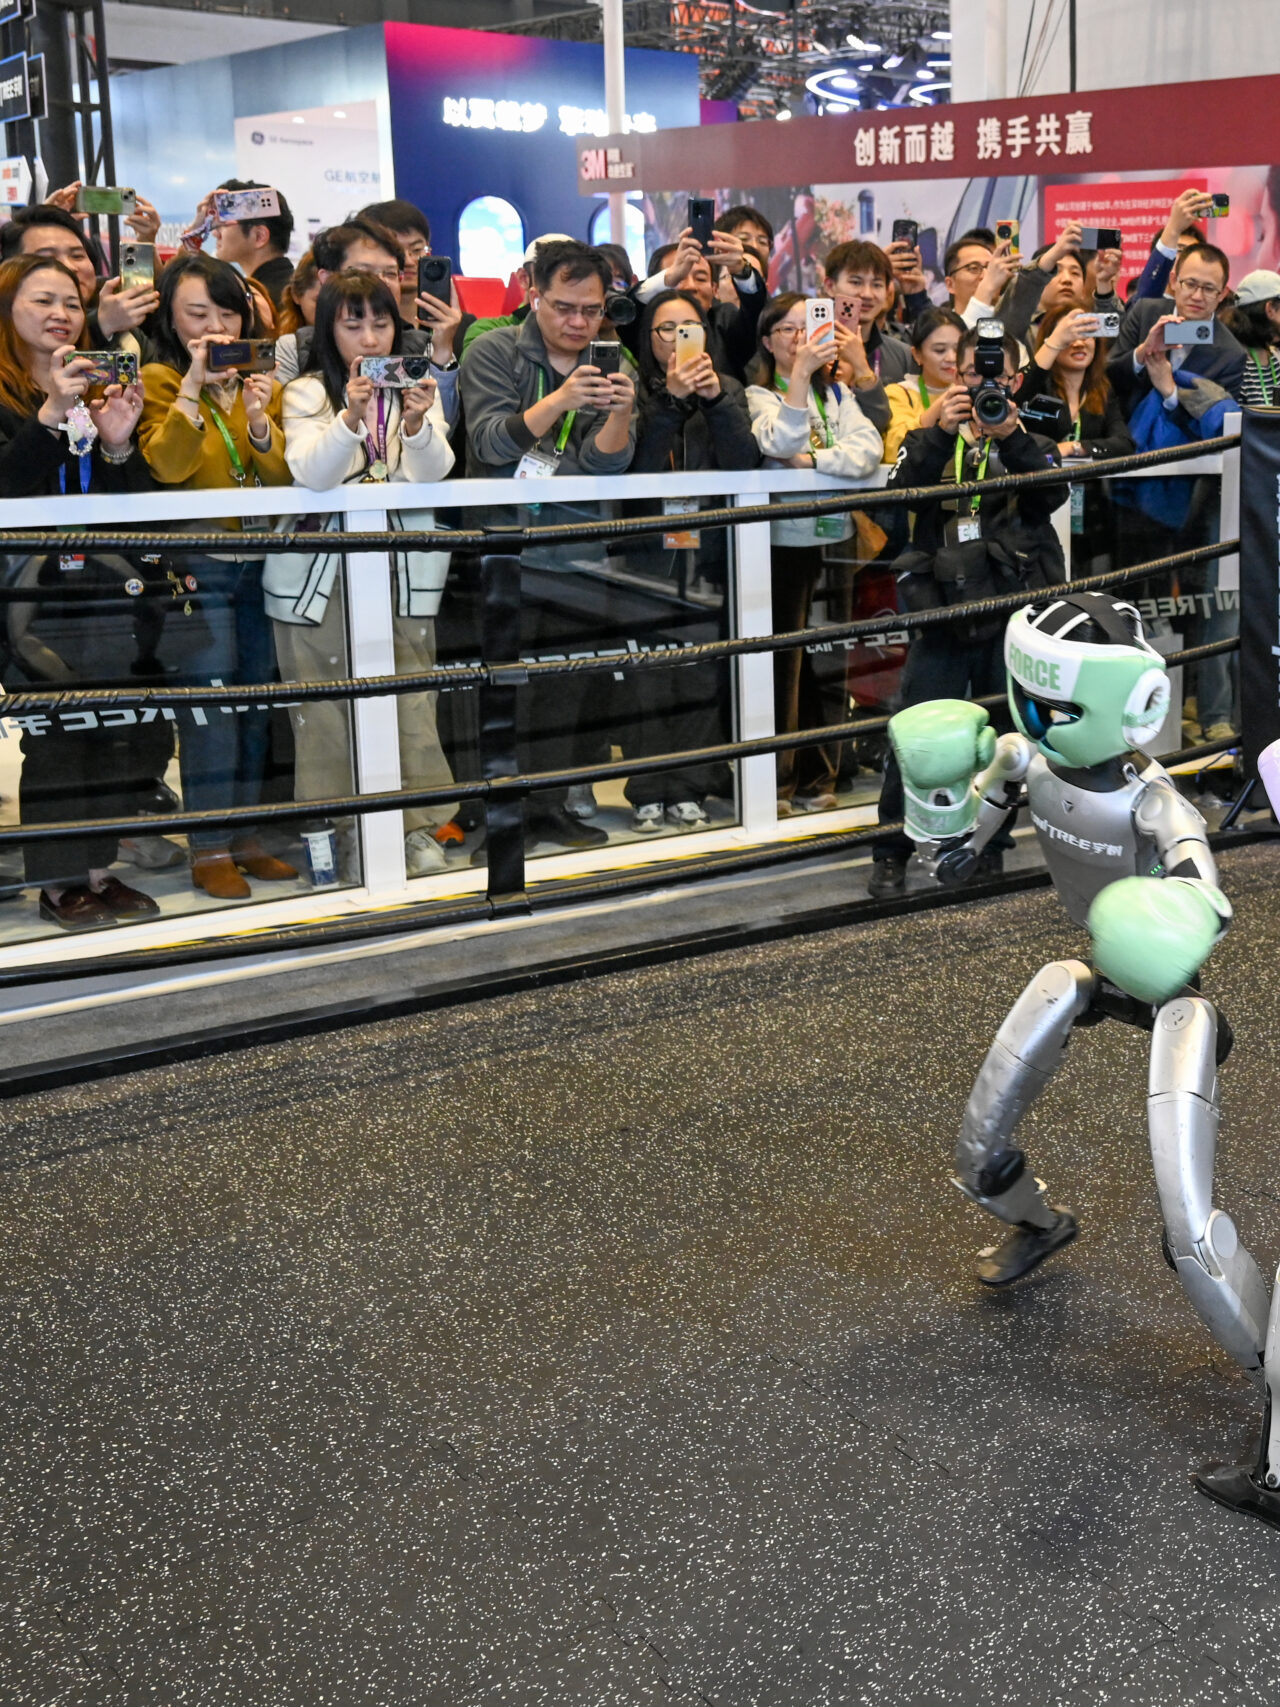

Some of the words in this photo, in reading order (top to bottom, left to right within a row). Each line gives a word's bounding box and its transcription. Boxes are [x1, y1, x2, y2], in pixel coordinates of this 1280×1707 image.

[854, 120, 955, 166] 创新而越
[977, 110, 1093, 160] 携手共赢
[581, 149, 607, 181] 3M
[1009, 641, 1061, 691] FORCE
